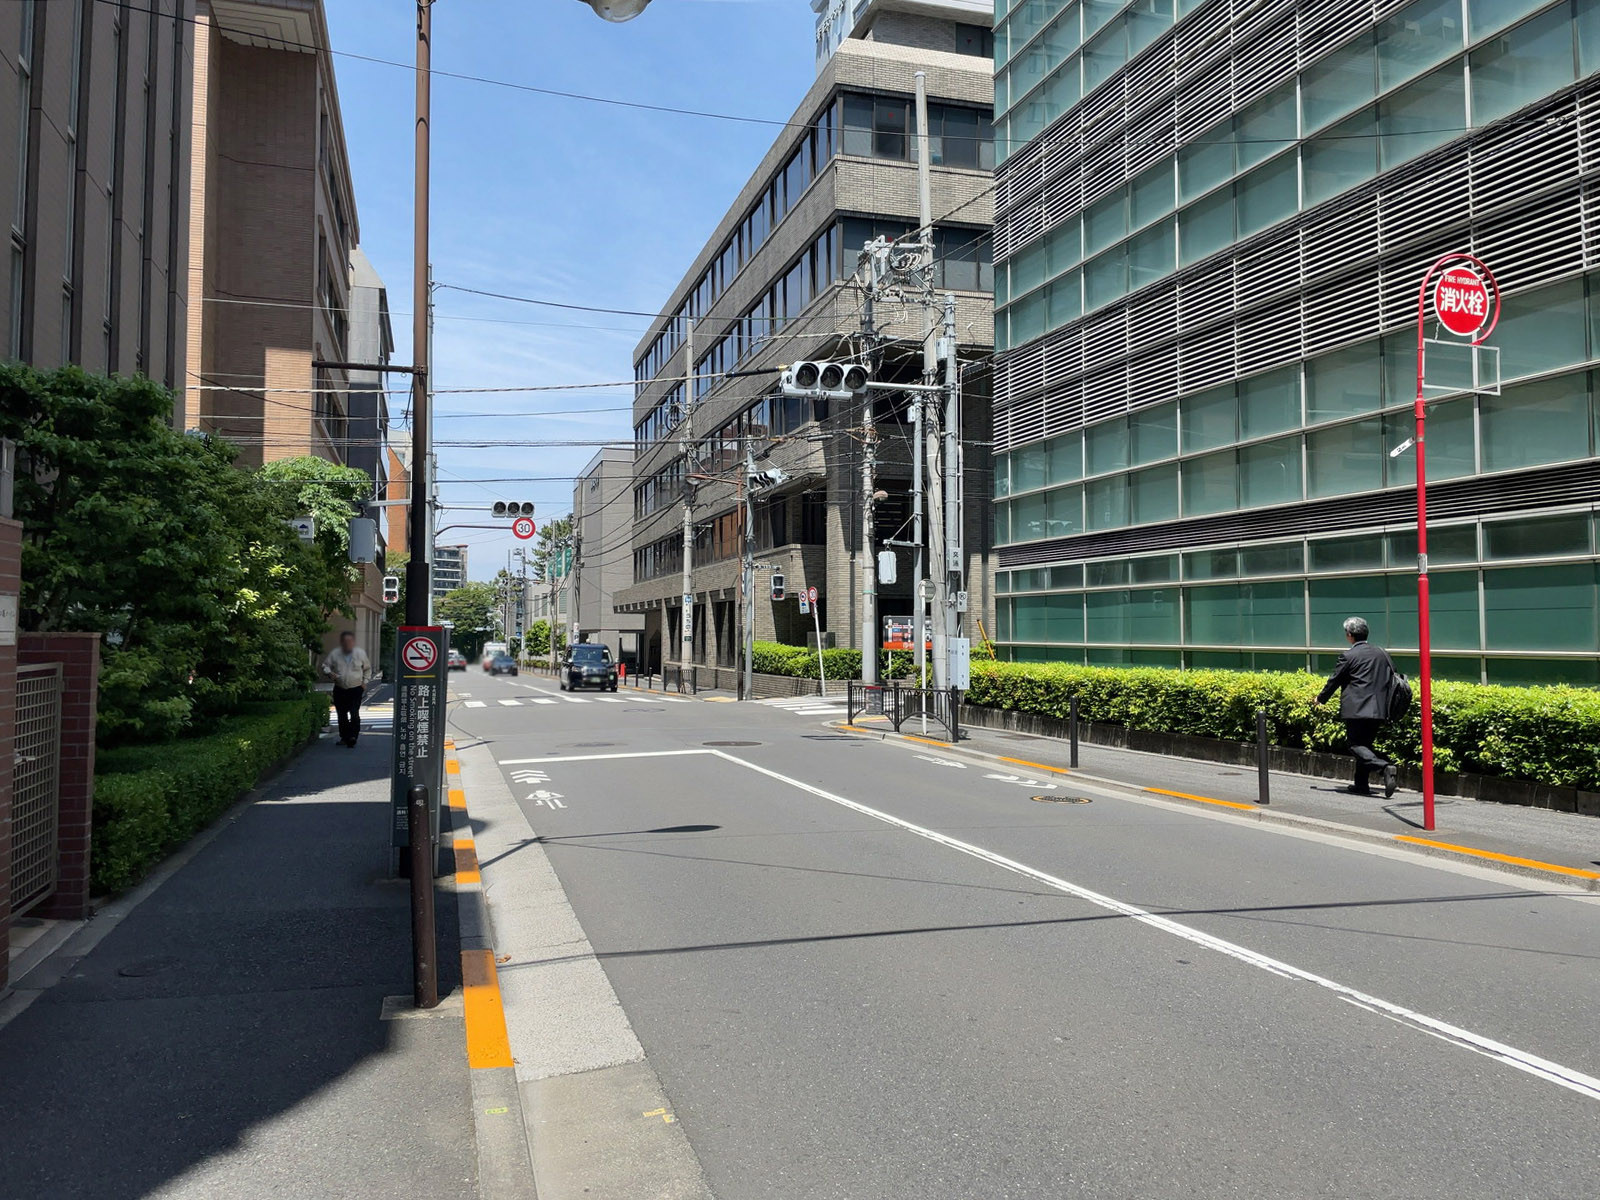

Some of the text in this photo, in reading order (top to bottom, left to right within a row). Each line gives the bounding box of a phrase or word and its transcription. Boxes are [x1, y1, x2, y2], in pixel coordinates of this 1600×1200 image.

[1445, 275, 1480, 286] FIRE HYDRANT
[1440, 287, 1484, 316] 消火栓
[518, 523, 531, 533] 30
[410, 685, 416, 696] No
[408, 698, 416, 729] Smoking
[416, 685, 429, 758] 路上喫煙禁止
[409, 731, 415, 740] on
